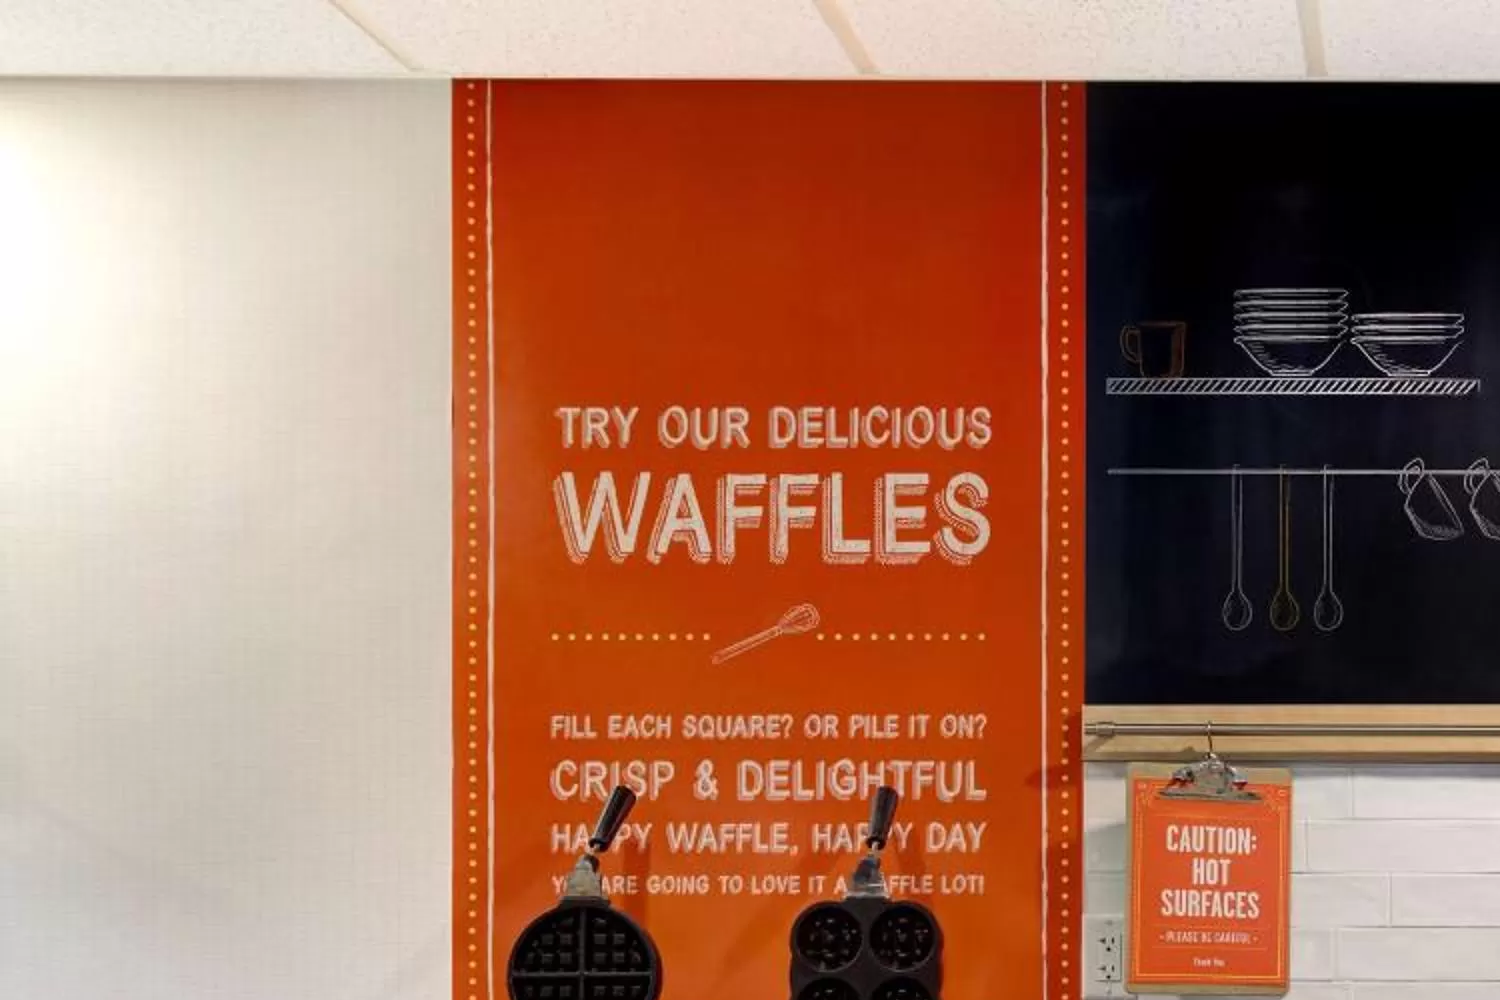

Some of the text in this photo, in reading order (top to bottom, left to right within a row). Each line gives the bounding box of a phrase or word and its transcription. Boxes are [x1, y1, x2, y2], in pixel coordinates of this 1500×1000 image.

[556, 406, 993, 449] TRY OUR DELICIOUS
[553, 471, 992, 565] WAFFLES
[551, 713, 987, 740] FILL EACH SQUARE? OR PILE IT ON?
[551, 760, 987, 802] CRISP & DELIGHTFUL
[552, 821, 987, 857] HAPY WAFFLE, HAPY DAY
[1165, 824, 1257, 855] CAUTION:
[647, 874, 710, 896] GOING
[718, 875, 744, 896] TO
[752, 874, 800, 895] LOVE
[808, 874, 827, 895] IT
[1192, 858, 1232, 886] HOT
[1160, 889, 1260, 919] SURFACES
